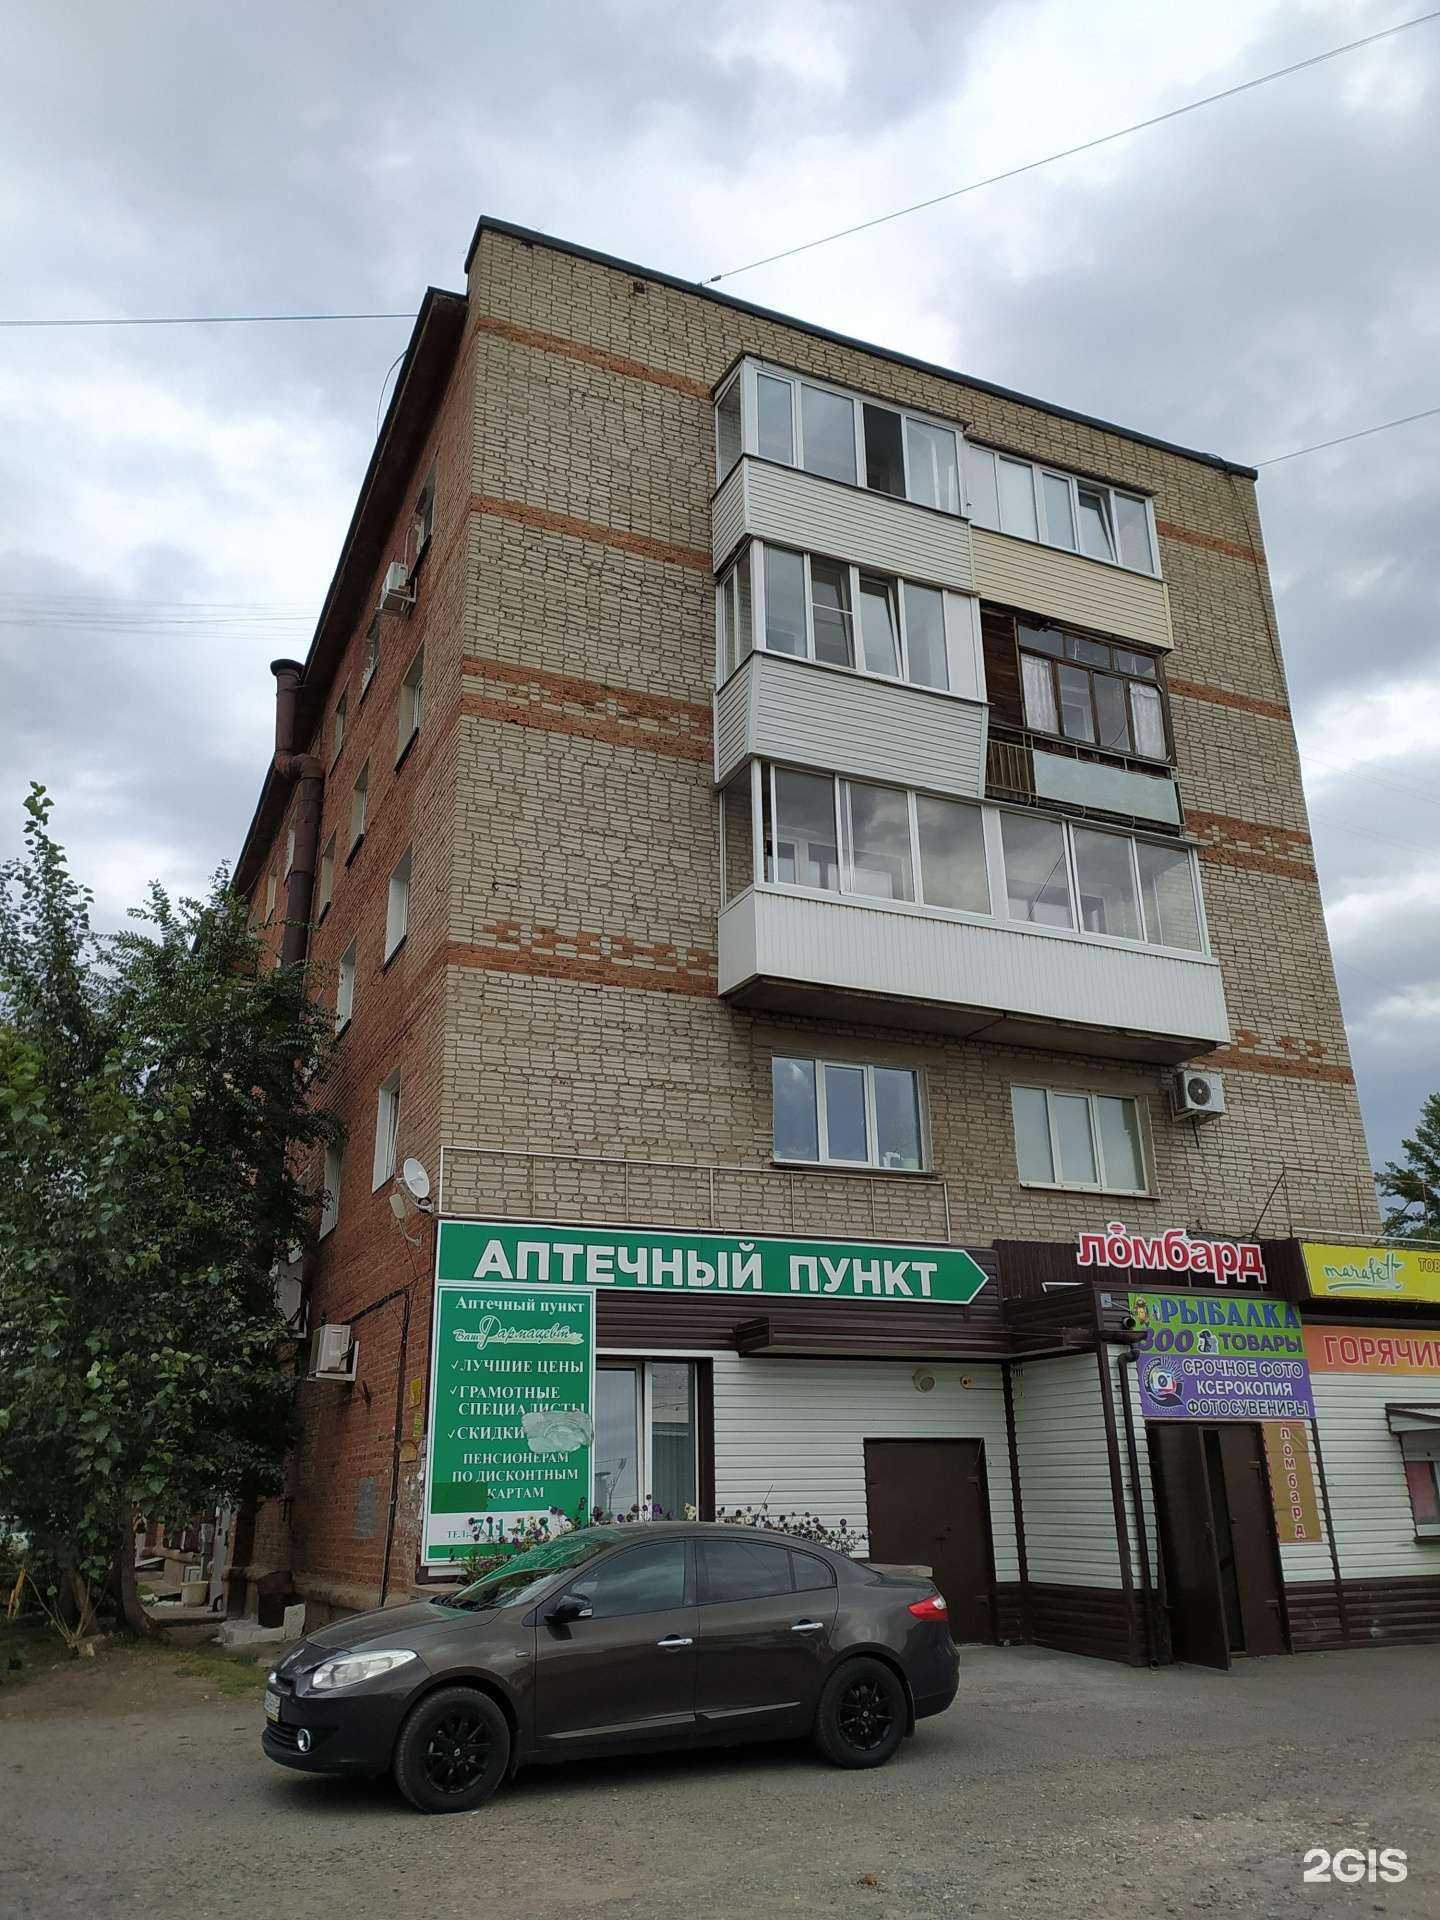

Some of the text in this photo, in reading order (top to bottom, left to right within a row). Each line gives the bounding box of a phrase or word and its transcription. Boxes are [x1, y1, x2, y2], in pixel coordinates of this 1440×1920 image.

[1077, 1222, 1267, 1285] ломбард
[473, 1239, 938, 1298] АПТЕЧНЫЙ ПУНКТ
[455, 1295, 585, 1315] Аптечный пункт
[1159, 1297, 1302, 1329] РЫБАЛКА
[477, 1314, 570, 1350] Фармацевт
[1219, 1332, 1304, 1353] ТОВАРЫ
[460, 1360, 584, 1374] ЛУЧШИЕ ЦЕНЫ
[1182, 1358, 1258, 1377] СРОЧНОЕ
[1260, 1361, 1304, 1378] ФОТО
[459, 1386, 560, 1399] ГРАМОТНЫЕ
[1196, 1380, 1294, 1397] КСЕРОКОПИЯ
[1186, 1399, 1310, 1417] ФОТОСУВЕНИРЫ
[457, 1426, 524, 1440] СКИДКИ
[463, 1452, 569, 1464] ПЕНСИОНЕРАМ
[452, 1469, 578, 1483] ПО ДИСКОНТНЫМ
[1281, 1427, 1306, 1539] ломбард
[487, 1487, 544, 1499] КАРТАМ
